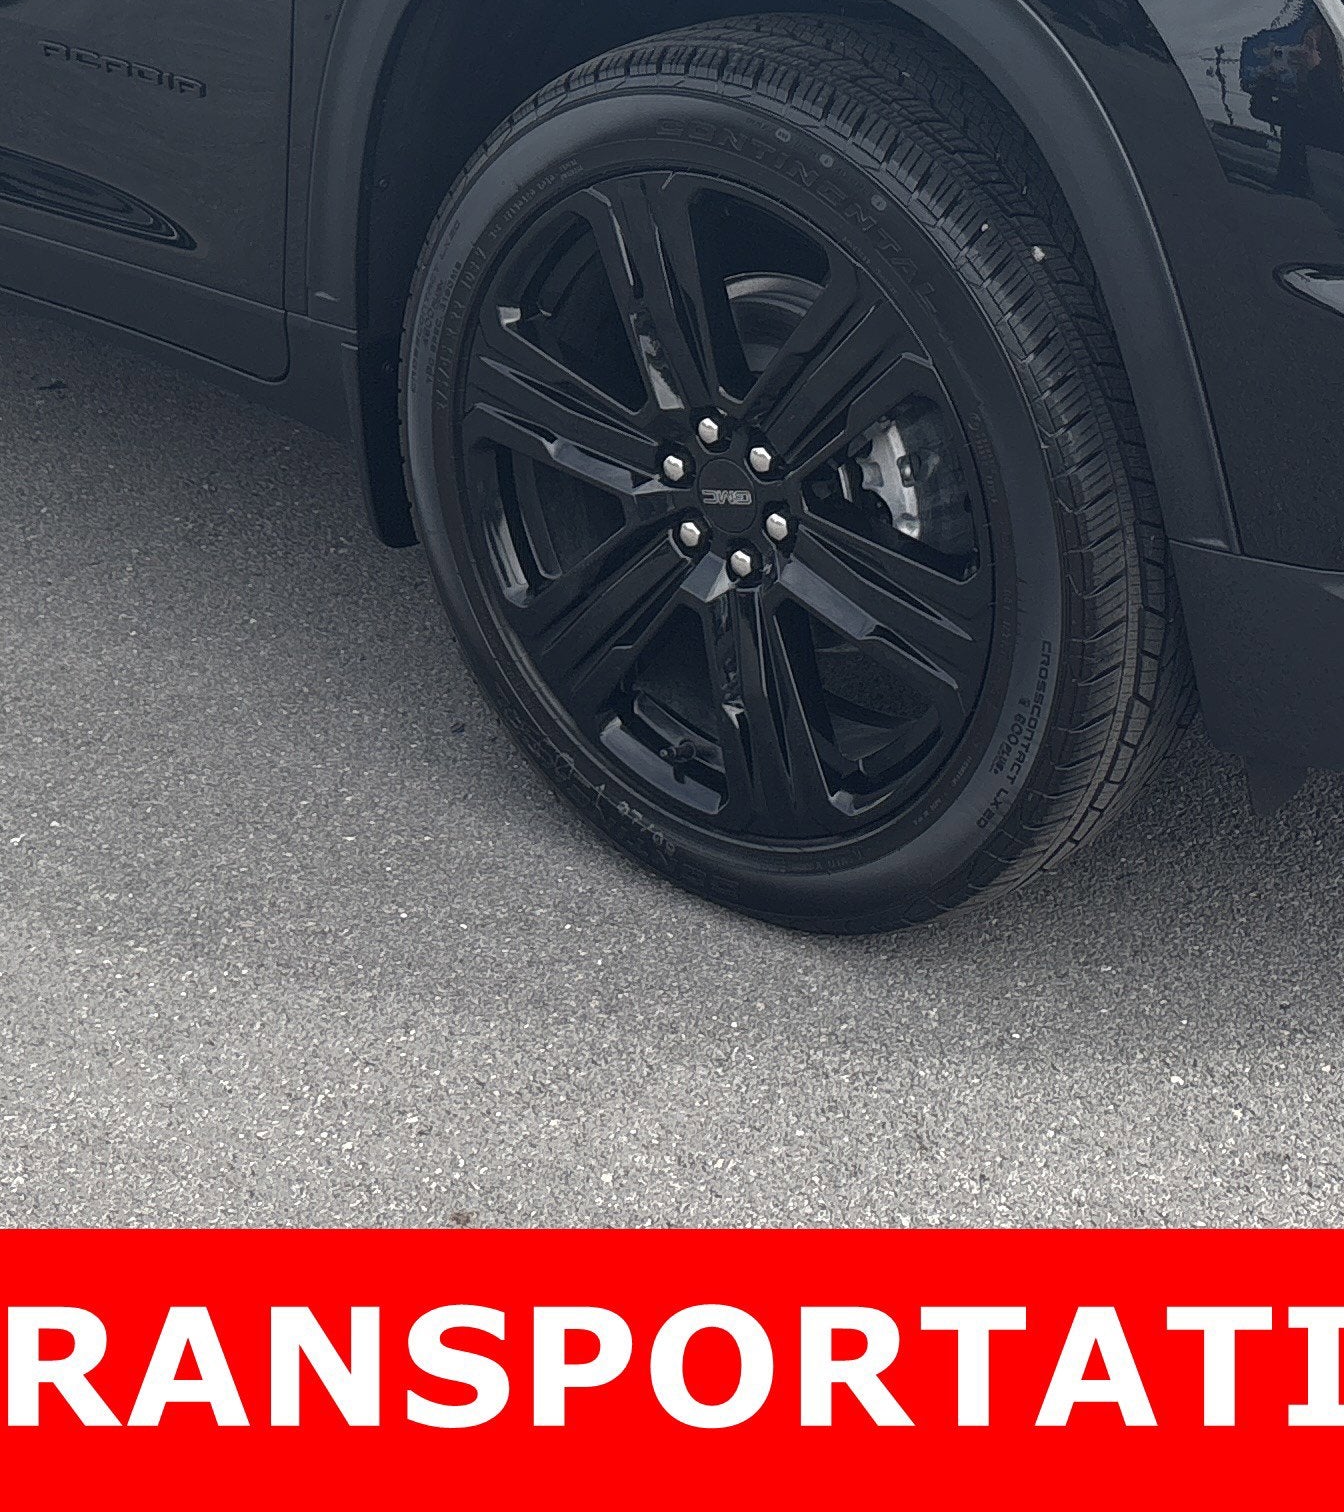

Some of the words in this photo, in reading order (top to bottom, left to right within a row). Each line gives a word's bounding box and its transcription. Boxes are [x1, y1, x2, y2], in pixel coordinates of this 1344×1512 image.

[37, 39, 207, 99] ACADIA
[701, 489, 753, 506] GMC
[1006, 640, 1052, 786] CROSSCONTACT
